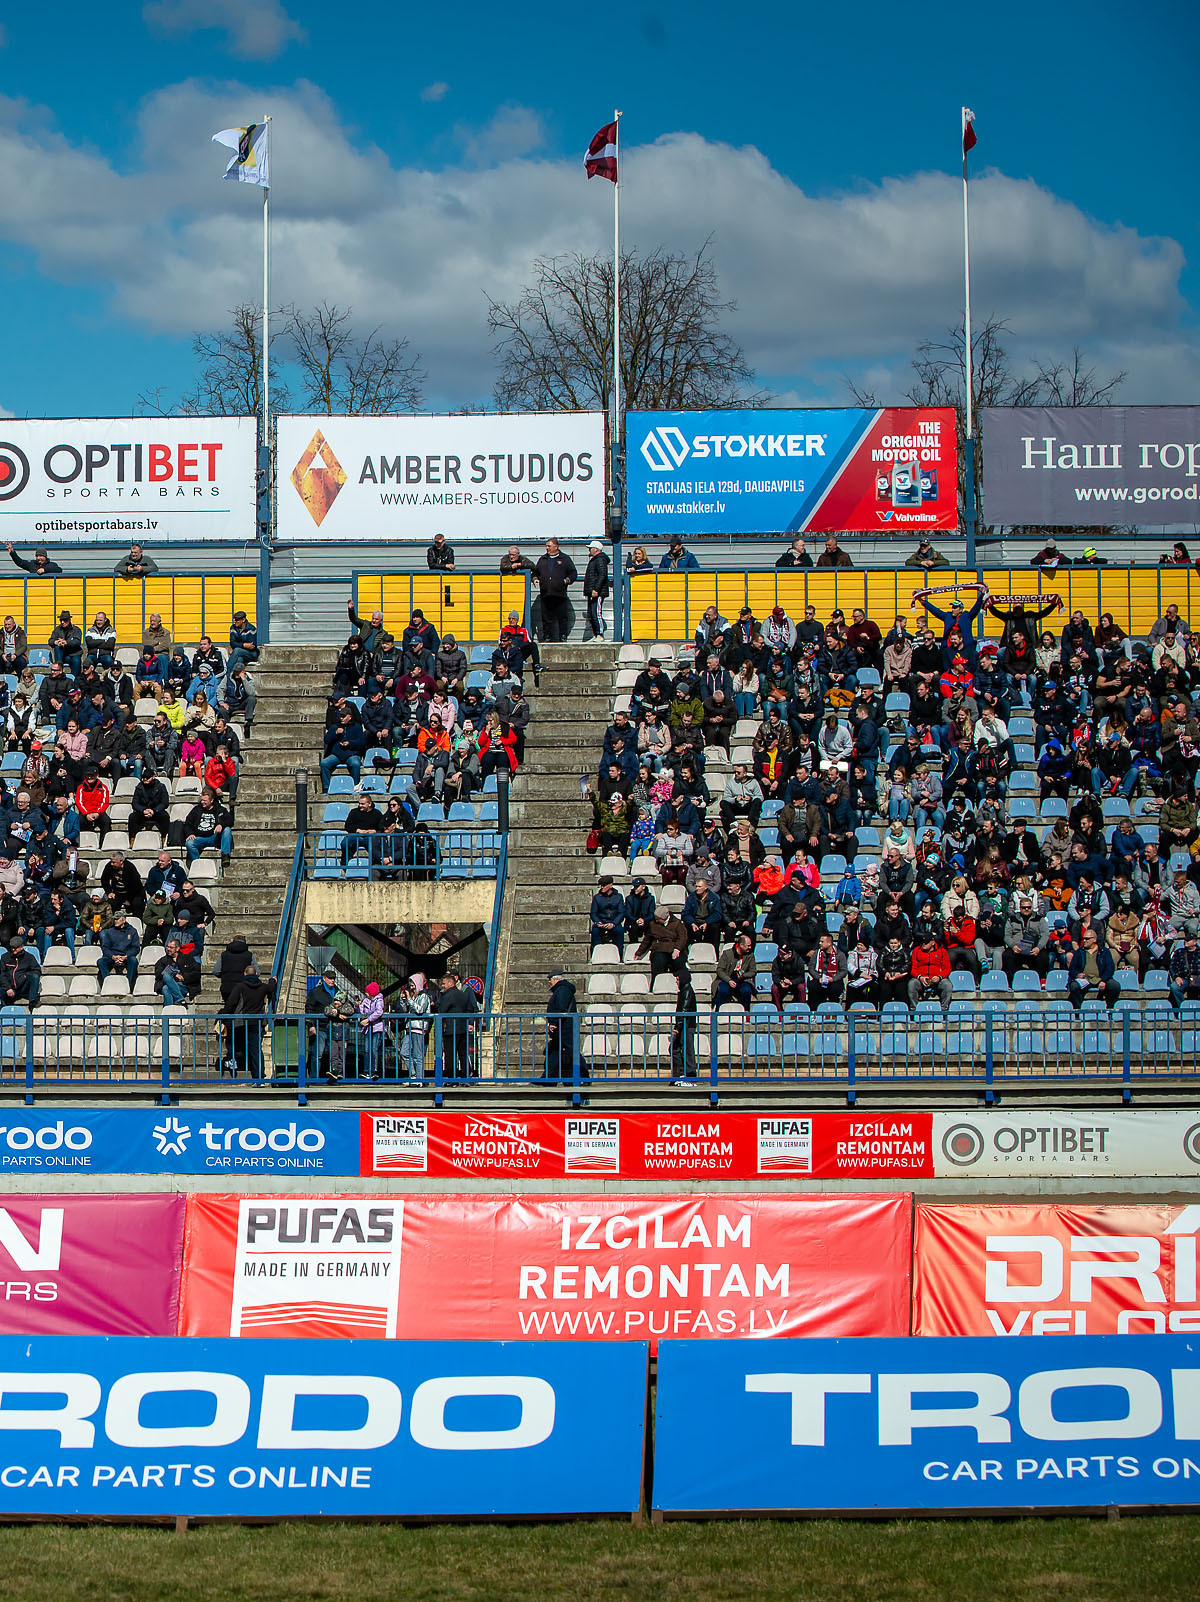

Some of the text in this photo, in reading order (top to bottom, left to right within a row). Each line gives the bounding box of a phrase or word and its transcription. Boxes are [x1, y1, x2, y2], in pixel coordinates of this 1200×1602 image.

[918, 422, 940, 434] THE
[691, 435, 824, 457] STOKKER
[882, 436, 941, 447] ORIGINAL
[872, 449, 941, 461] MOTOR OIL
[1021, 437, 1122, 468] Наш
[44, 444, 222, 483] OPTIBET
[359, 453, 593, 484] AMBER STUDIOS
[47, 486, 219, 497] SPORTA BĀRS
[647, 482, 692, 493] STACIJAS
[695, 481, 715, 493] IELA
[745, 480, 804, 492] DAUGAVPILS
[380, 491, 573, 505] WWW.AMBER-STUDIOS.COM
[647, 501, 725, 513] www.stokker.lv
[35, 519, 158, 533] optibetsportabars.lv
[444, 585, 455, 607] L
[992, 594, 1056, 602] LOKOMOTIV
[377, 1120, 424, 1133] PUFAS
[465, 1124, 527, 1137] IZCILAM
[568, 1122, 616, 1135] PUFAS
[657, 1124, 719, 1137] IZCILAM
[761, 1122, 809, 1135] PUFAS
[850, 1123, 912, 1136] IZCILAM
[199, 1123, 325, 1151] trodo
[994, 1128, 1109, 1153] OPTIBET
[452, 1141, 540, 1155] REMONTAM
[645, 1142, 732, 1155] REMONTAM
[837, 1141, 924, 1154] REMONTAM
[3, 1156, 41, 1165] PARTS
[45, 1157, 91, 1166] ONLINE
[206, 1157, 324, 1168] CAR PARTS ONLINE
[452, 1158, 540, 1168] WWW.PUFAS.LV
[645, 1159, 732, 1168] WWW.PUFAS.LV
[837, 1158, 924, 1167] WWW.PUFAS.LV
[247, 1208, 394, 1243] PUFAS
[562, 1215, 751, 1250] IZCILAM
[244, 1263, 390, 1277] MADE IN GERMANY
[520, 1264, 790, 1299] REMONTAM
[518, 1309, 790, 1335] WWW.PUFAS.LV
[745, 1367, 1200, 1446] TRO
[923, 1460, 1003, 1480] CAR
[1017, 1456, 1139, 1479] PARTS
[1, 1464, 372, 1488] CAR PARTS ONLINE
